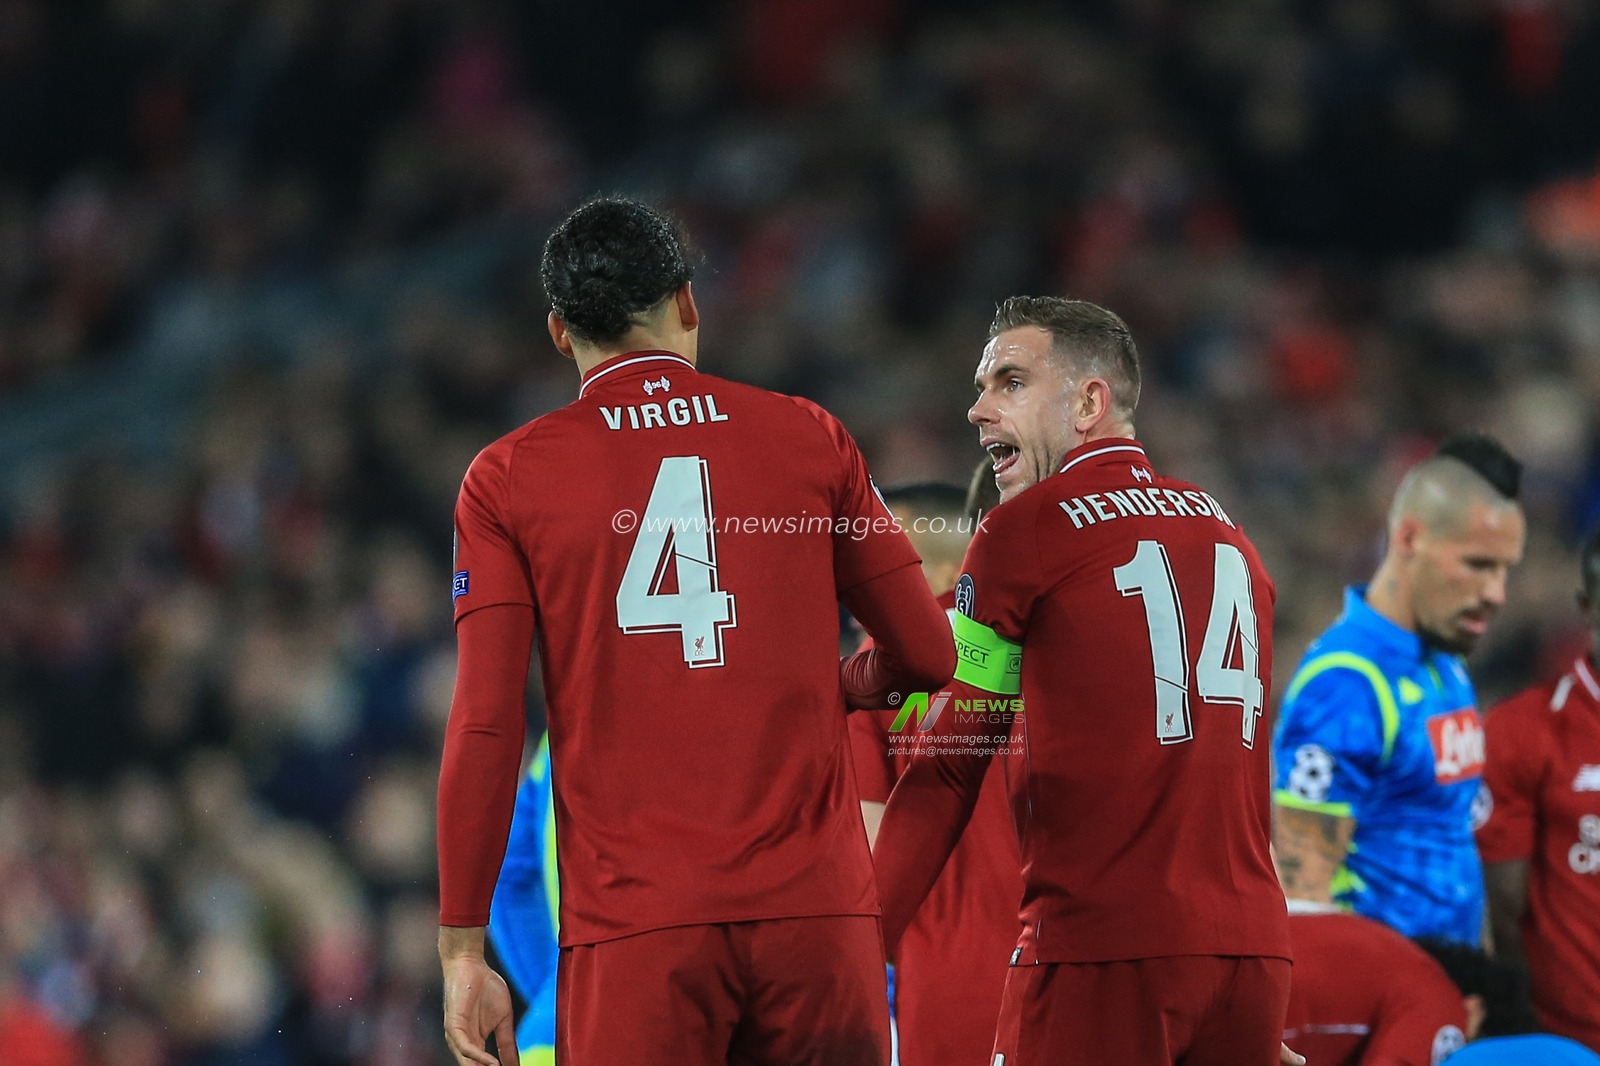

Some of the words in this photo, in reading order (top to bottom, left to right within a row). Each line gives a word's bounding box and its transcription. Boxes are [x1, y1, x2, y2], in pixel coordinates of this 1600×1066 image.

[598, 394, 729, 430] VIRGIL
[616, 455, 738, 669] 4
[956, 640, 989, 664] PECT
[1113, 539, 1264, 750] 14
